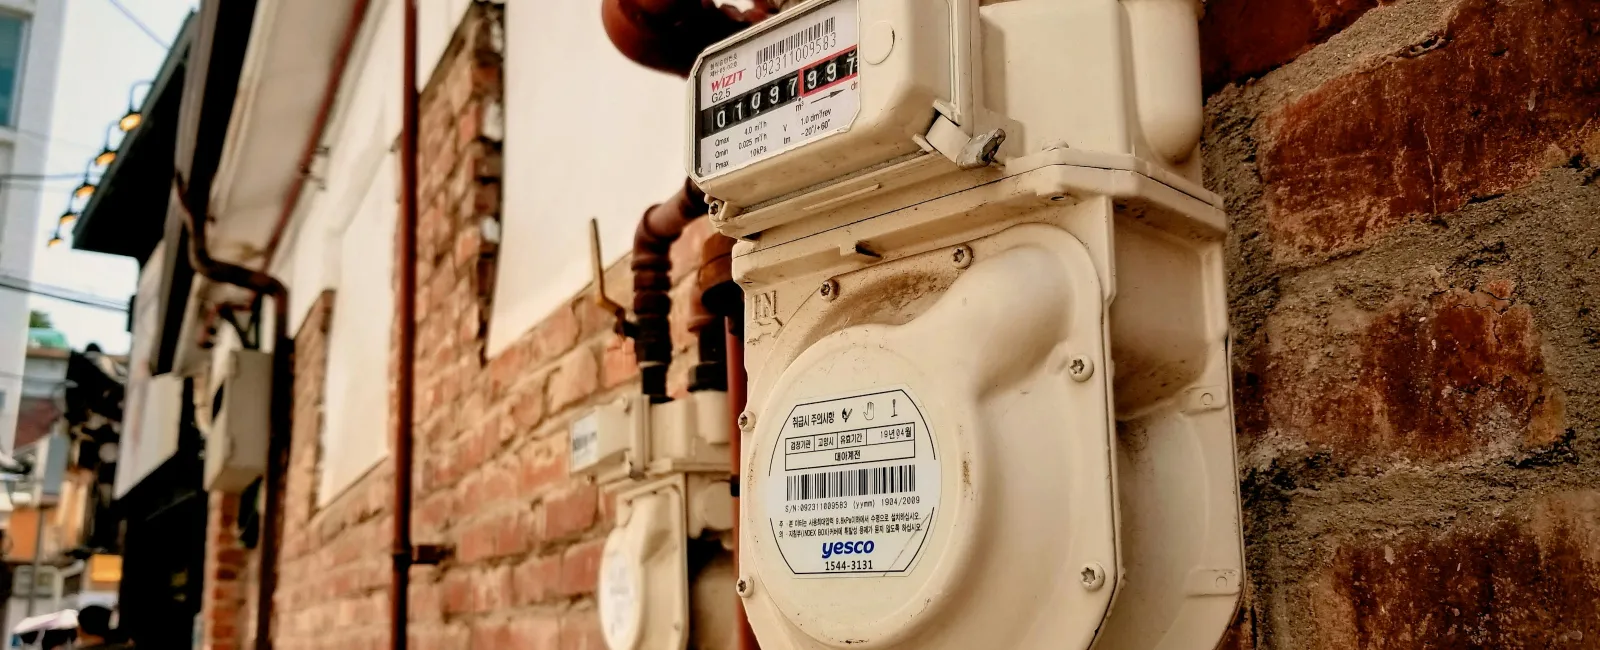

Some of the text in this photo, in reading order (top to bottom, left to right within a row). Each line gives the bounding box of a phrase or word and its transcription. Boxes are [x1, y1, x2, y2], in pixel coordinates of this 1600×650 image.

[755, 32, 837, 80] 092311009583
[711, 68, 746, 92] WIZIT
[712, 88, 730, 103] G2.5
[783, 124, 788, 132] V
[800, 115, 810, 126] 1.0
[714, 136, 730, 147] Qmax
[744, 126, 752, 136] 4.0
[714, 148, 728, 159] Qmin
[738, 138, 752, 150] 0.025
[715, 160, 730, 170] Pmax
[792, 412, 835, 428] 취급시 주의사항
[840, 433, 862, 445] 유효기간
[834, 450, 860, 462] 대아계전
[881, 496, 920, 506] 1904/2009
[821, 540, 875, 558] yesco
[825, 560, 874, 571] 1544-3131
